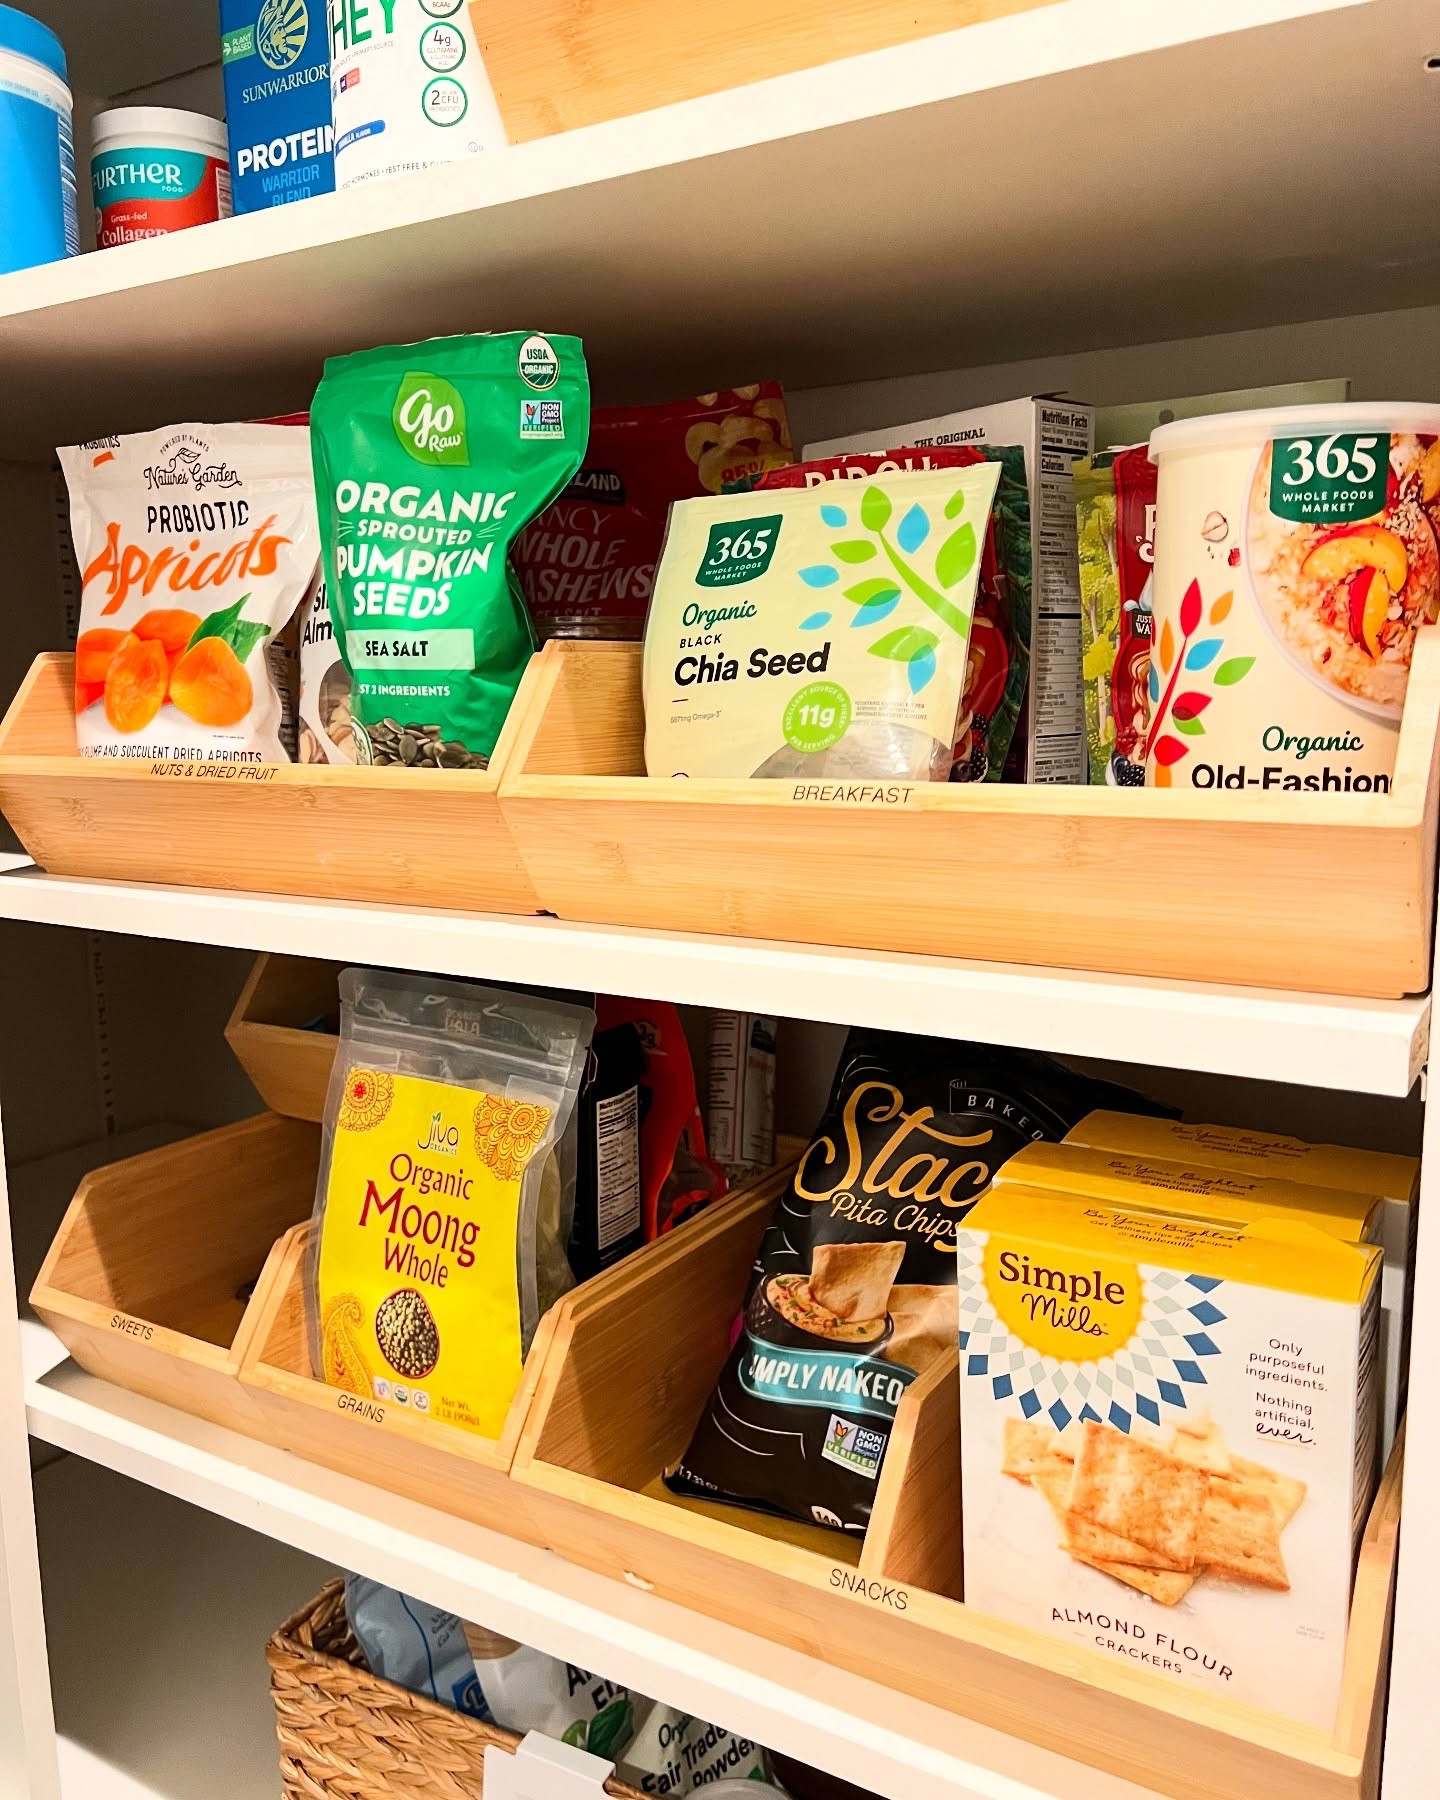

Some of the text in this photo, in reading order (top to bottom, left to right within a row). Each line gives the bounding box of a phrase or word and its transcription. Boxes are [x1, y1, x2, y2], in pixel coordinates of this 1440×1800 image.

[433, 29, 451, 47] 4g
[242, 63, 329, 104] SUNWARRIOR
[431, 89, 459, 106] 2 CFU
[237, 124, 336, 177] PROTEIN
[262, 164, 320, 193] WARRIOR
[402, 161, 420, 171] FREE
[161, 185, 184, 193] FOOD
[272, 186, 311, 207] BLEND
[110, 211, 148, 223] Grass-fed
[526, 348, 549, 360] USDA
[524, 364, 554, 375] ORGANIC
[541, 403, 560, 411] NON
[541, 410, 560, 418] GMO
[428, 433, 463, 453] Raw
[936, 427, 986, 446] ORIGINAL
[1282, 432, 1379, 486] 365
[188, 462, 243, 491] Garden
[335, 479, 516, 523] ORGANIC
[1282, 490, 1374, 503] WHOLE FOODS
[1301, 502, 1355, 513] MARKET
[147, 499, 250, 534] PROBIOTIC
[356, 518, 472, 546] SPROUTED
[708, 528, 773, 566] 365
[81, 513, 294, 617] Apricots
[336, 541, 495, 582] PUMPKIN
[705, 561, 763, 576] WHOLE FOODS
[713, 571, 748, 581] MARKET
[352, 581, 454, 620] SEEDS
[682, 600, 758, 631] Organic
[364, 640, 429, 657] SEA SALT
[678, 633, 723, 649] BLACK
[673, 642, 832, 686] Chia Seed
[371, 685, 379, 696] 2
[377, 685, 451, 697] INGREDIENTS
[798, 703, 837, 729] 11g
[103, 745, 119, 758] AND
[120, 745, 169, 760] SUCCULENT
[173, 747, 203, 761] DRIED
[208, 749, 263, 764] APRICOTS
[1262, 724, 1365, 760] Organic
[150, 763, 280, 780] NUTS & DRIED FRUIT
[1191, 763, 1394, 794] Old-Fashion
[792, 784, 915, 804] BREAKFAST
[967, 1093, 1045, 1142] BAKED
[389, 1152, 475, 1201] Organic
[358, 1179, 481, 1269] Moong
[830, 1190, 960, 1244] Pita Chips
[1082, 1208, 1247, 1242] Be Your Brightest
[1089, 1219, 1108, 1227] Get
[1153, 1229, 1173, 1239] tips
[1193, 1237, 1233, 1249] recipes
[1117, 1231, 1195, 1249] @simplemills
[384, 1237, 449, 1289] Whole
[999, 1250, 1126, 1306] Simple
[110, 1313, 154, 1341] SWEETS
[1021, 1291, 1110, 1337] Mills
[1268, 1338, 1303, 1357] Only
[1245, 1364, 1329, 1392] ingredients.
[1249, 1352, 1325, 1376] purposeful
[818, 1364, 905, 1406] NAKED
[337, 1393, 385, 1423] GRAINS
[434, 1406, 441, 1416] 2
[441, 1396, 455, 1407] Net
[1255, 1391, 1313, 1416] Nothing
[1255, 1408, 1315, 1432] artificial,
[1255, 1421, 1318, 1446] ever.
[855, 1438, 881, 1452] GMO
[857, 1429, 883, 1444] NON
[826, 1440, 877, 1469] VERIFIED
[829, 1567, 909, 1611] SNACKS
[1051, 1606, 1234, 1681] ALMOND FLOUR
[1094, 1634, 1183, 1675] CRACKERS
[640, 1722, 730, 1795] Fair Trade
